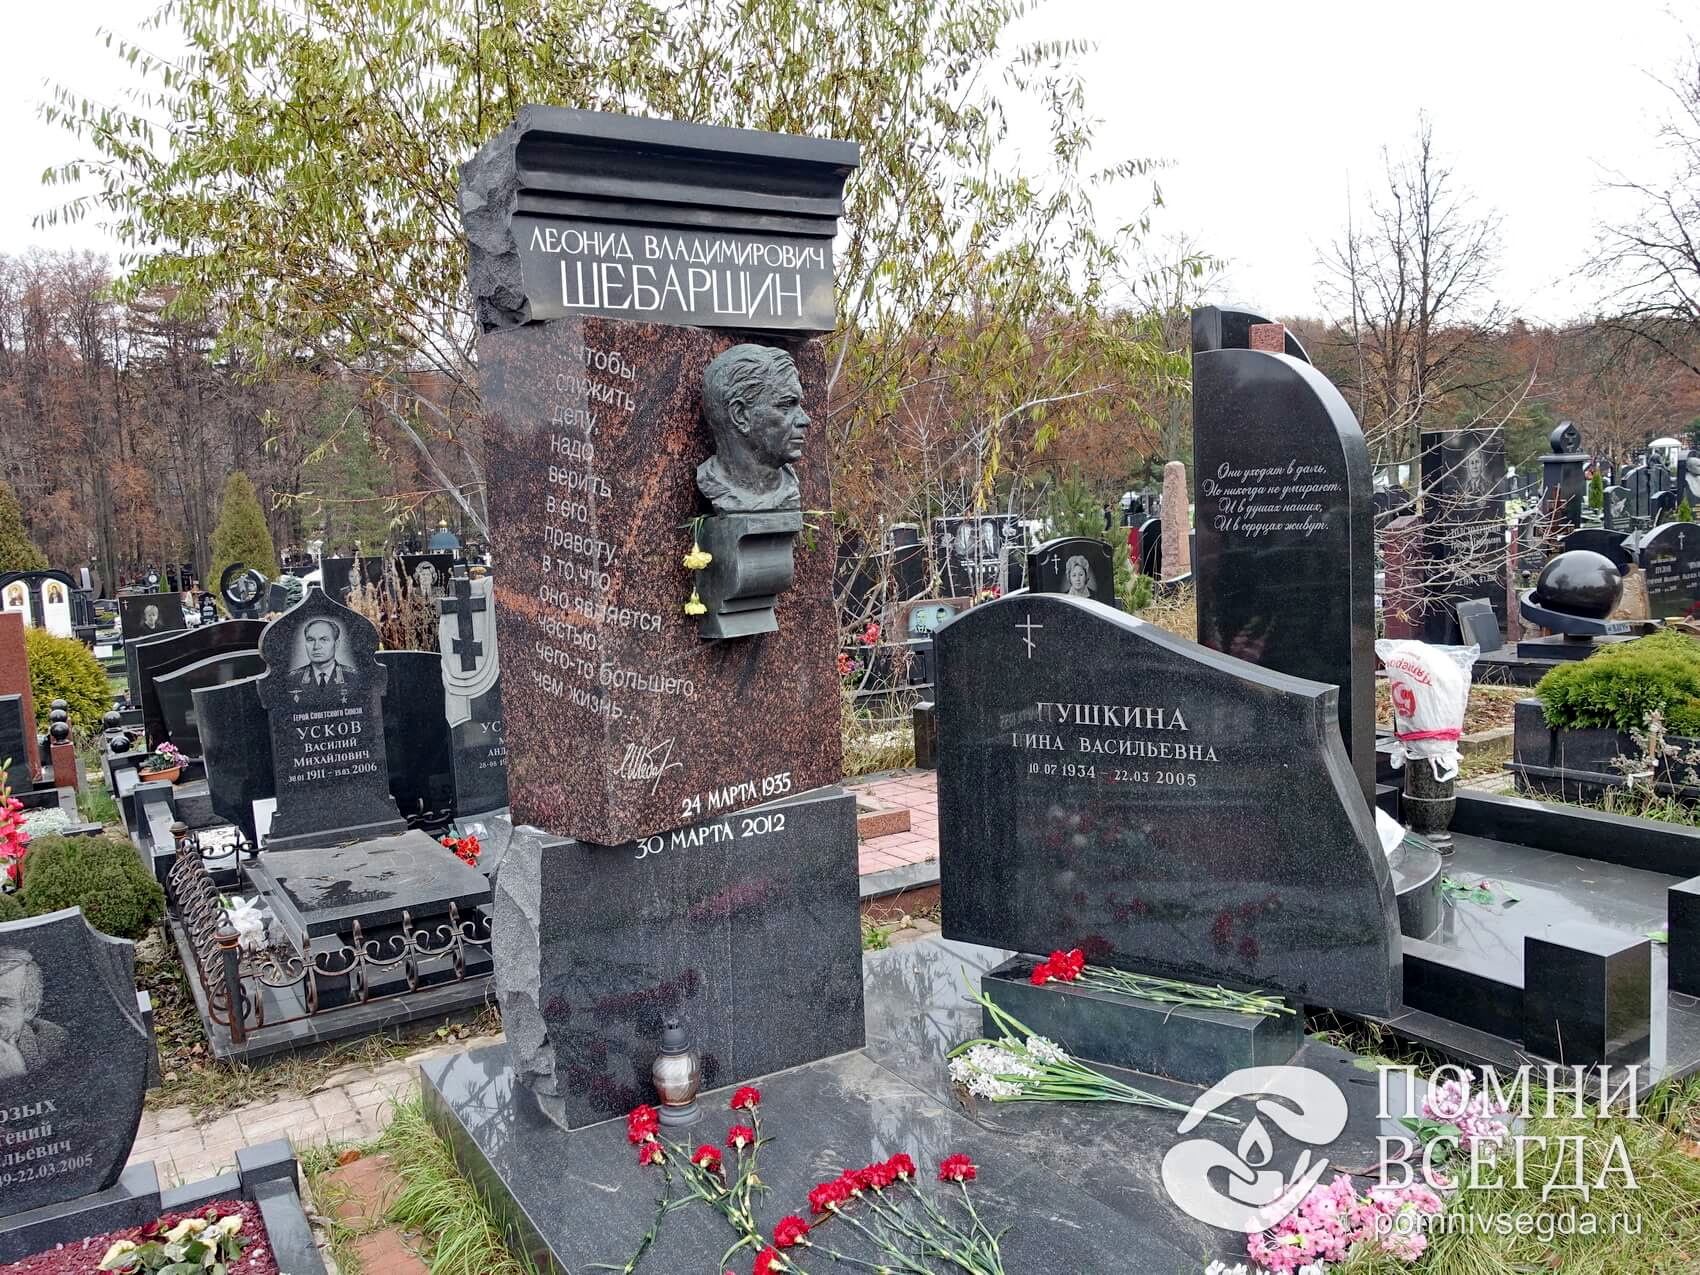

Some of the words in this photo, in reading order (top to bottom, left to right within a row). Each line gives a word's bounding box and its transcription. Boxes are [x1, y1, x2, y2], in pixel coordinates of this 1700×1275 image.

[530, 225, 634, 261] ЛЕОНИД
[644, 235, 825, 270] ВЛАДИМИРОВИЧ
[560, 260, 803, 319] ШЕБАРШИН
[556, 373, 636, 411] служить
[552, 405, 599, 435] делу,
[551, 434, 594, 462] надо
[548, 465, 612, 498] верить
[1217, 462, 1242, 480] Они
[1241, 467, 1285, 483] уходят
[1287, 459, 1296, 474] в
[1202, 478, 1223, 496] Но
[1223, 486, 1266, 501] никогда
[1267, 486, 1280, 494] не
[546, 496, 555, 513] в
[561, 500, 587, 522] его
[1238, 498, 1246, 513] в
[1244, 504, 1281, 519] душах
[1233, 516, 1241, 531] в
[1241, 523, 1283, 538] сердцах
[542, 555, 551, 573] в
[539, 585, 569, 609] оно
[574, 597, 662, 632] является
[535, 640, 594, 679] чего-то
[533, 670, 564, 698] чем
[296, 721, 362, 740] УСКОВ
[1037, 702, 1190, 732] ПУШКИНА
[304, 737, 357, 752] ВАСИЛИЙ
[1079, 737, 1221, 762] ВАСИЛЬЕВНА
[293, 750, 370, 767] МИХАЙЛОВИЧ
[306, 769, 325, 780] 1911
[352, 762, 378, 774] 2006
[1062, 763, 1096, 779] 1934
[1156, 771, 1197, 787] 2005
[682, 794, 700, 818] 24
[708, 780, 757, 811] МАРТА
[762, 772, 792, 796] 1935
[635, 836, 664, 859] 30
[671, 821, 734, 851] МАРТА
[741, 813, 785, 838] 2012
